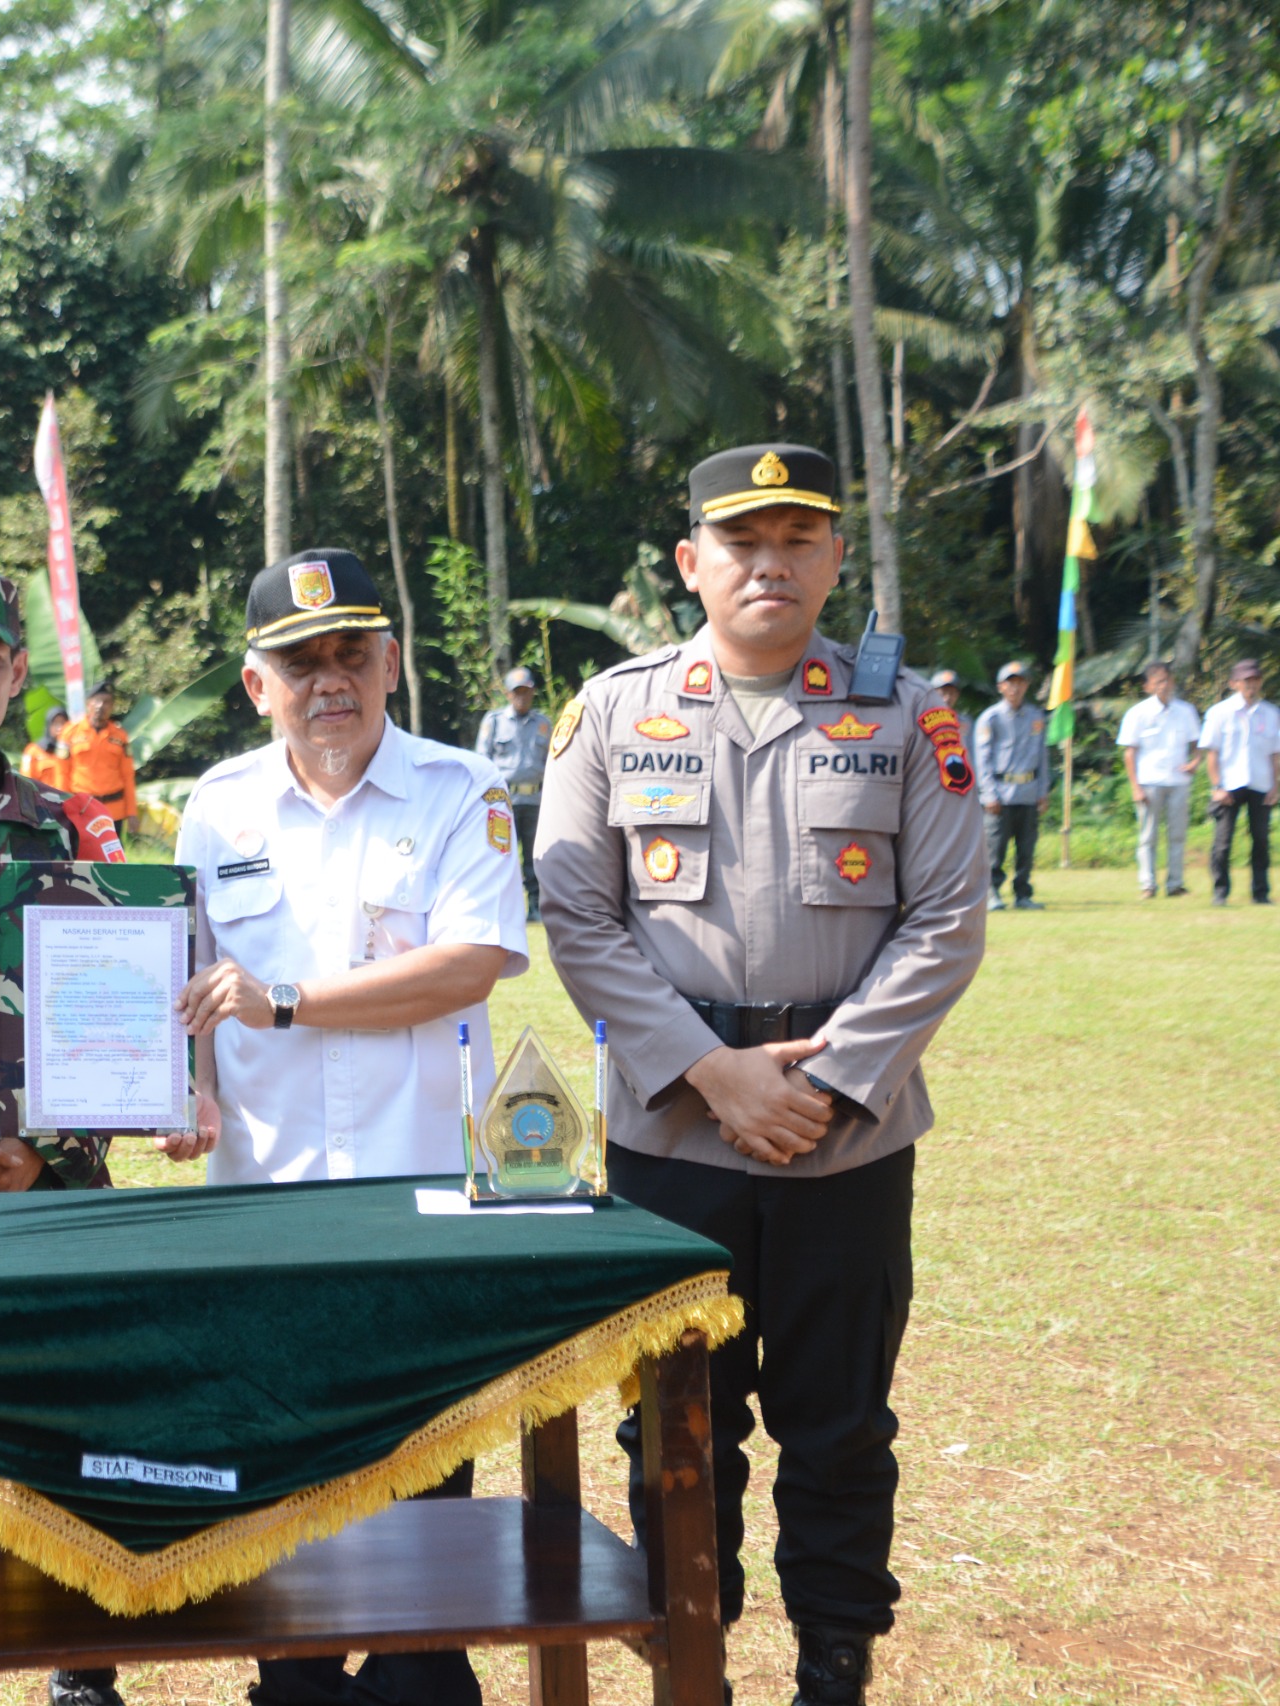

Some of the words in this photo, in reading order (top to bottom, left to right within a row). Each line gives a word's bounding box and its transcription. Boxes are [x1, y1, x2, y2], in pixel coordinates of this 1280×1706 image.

[620, 751, 704, 774] DAVID
[809, 753, 898, 776] POLRI
[62, 927, 92, 936] NASKAH
[93, 928, 117, 936] SERAH
[118, 928, 146, 937] TERIMA
[92, 1460, 135, 1475] STAF
[142, 1465, 228, 1488] PERSONEL
